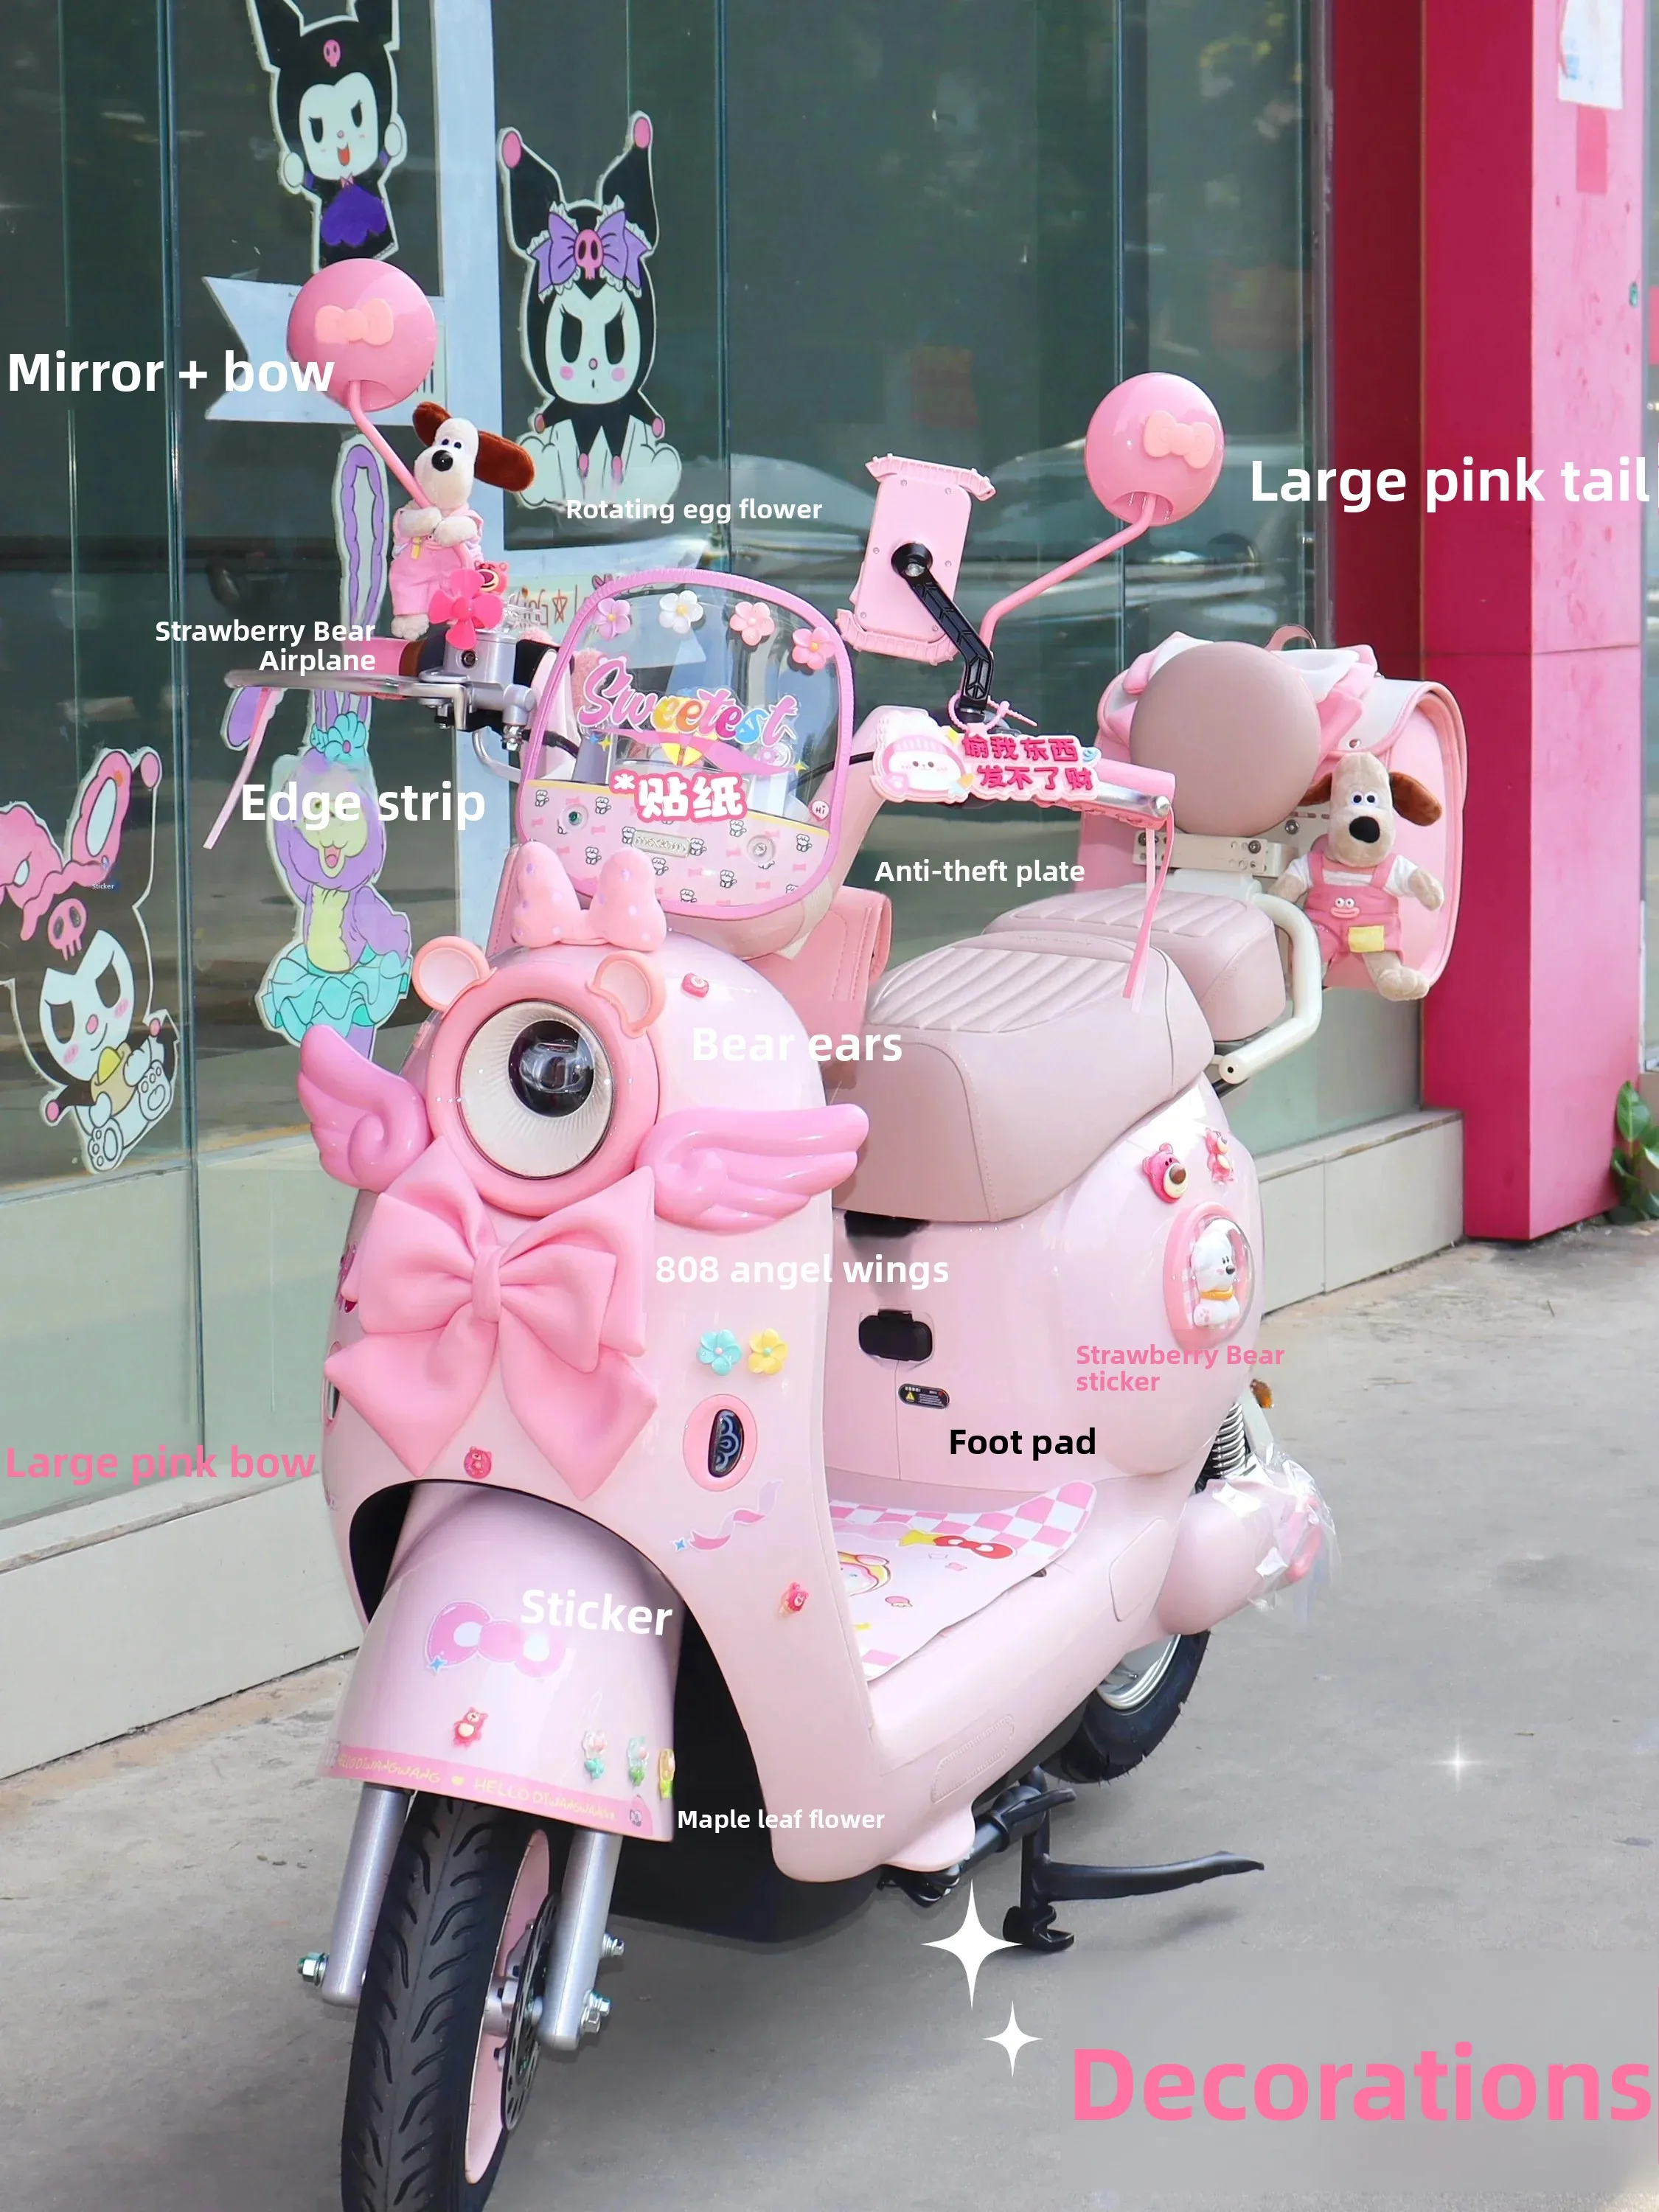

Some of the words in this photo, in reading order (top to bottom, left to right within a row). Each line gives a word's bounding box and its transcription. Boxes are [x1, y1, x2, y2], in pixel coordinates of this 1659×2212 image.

[577, 656, 797, 748] Sweetest
[961, 734, 1078, 762] 偷我东西
[977, 765, 1093, 790] 发不了财
[473, 1778, 529, 1801] HELLO
